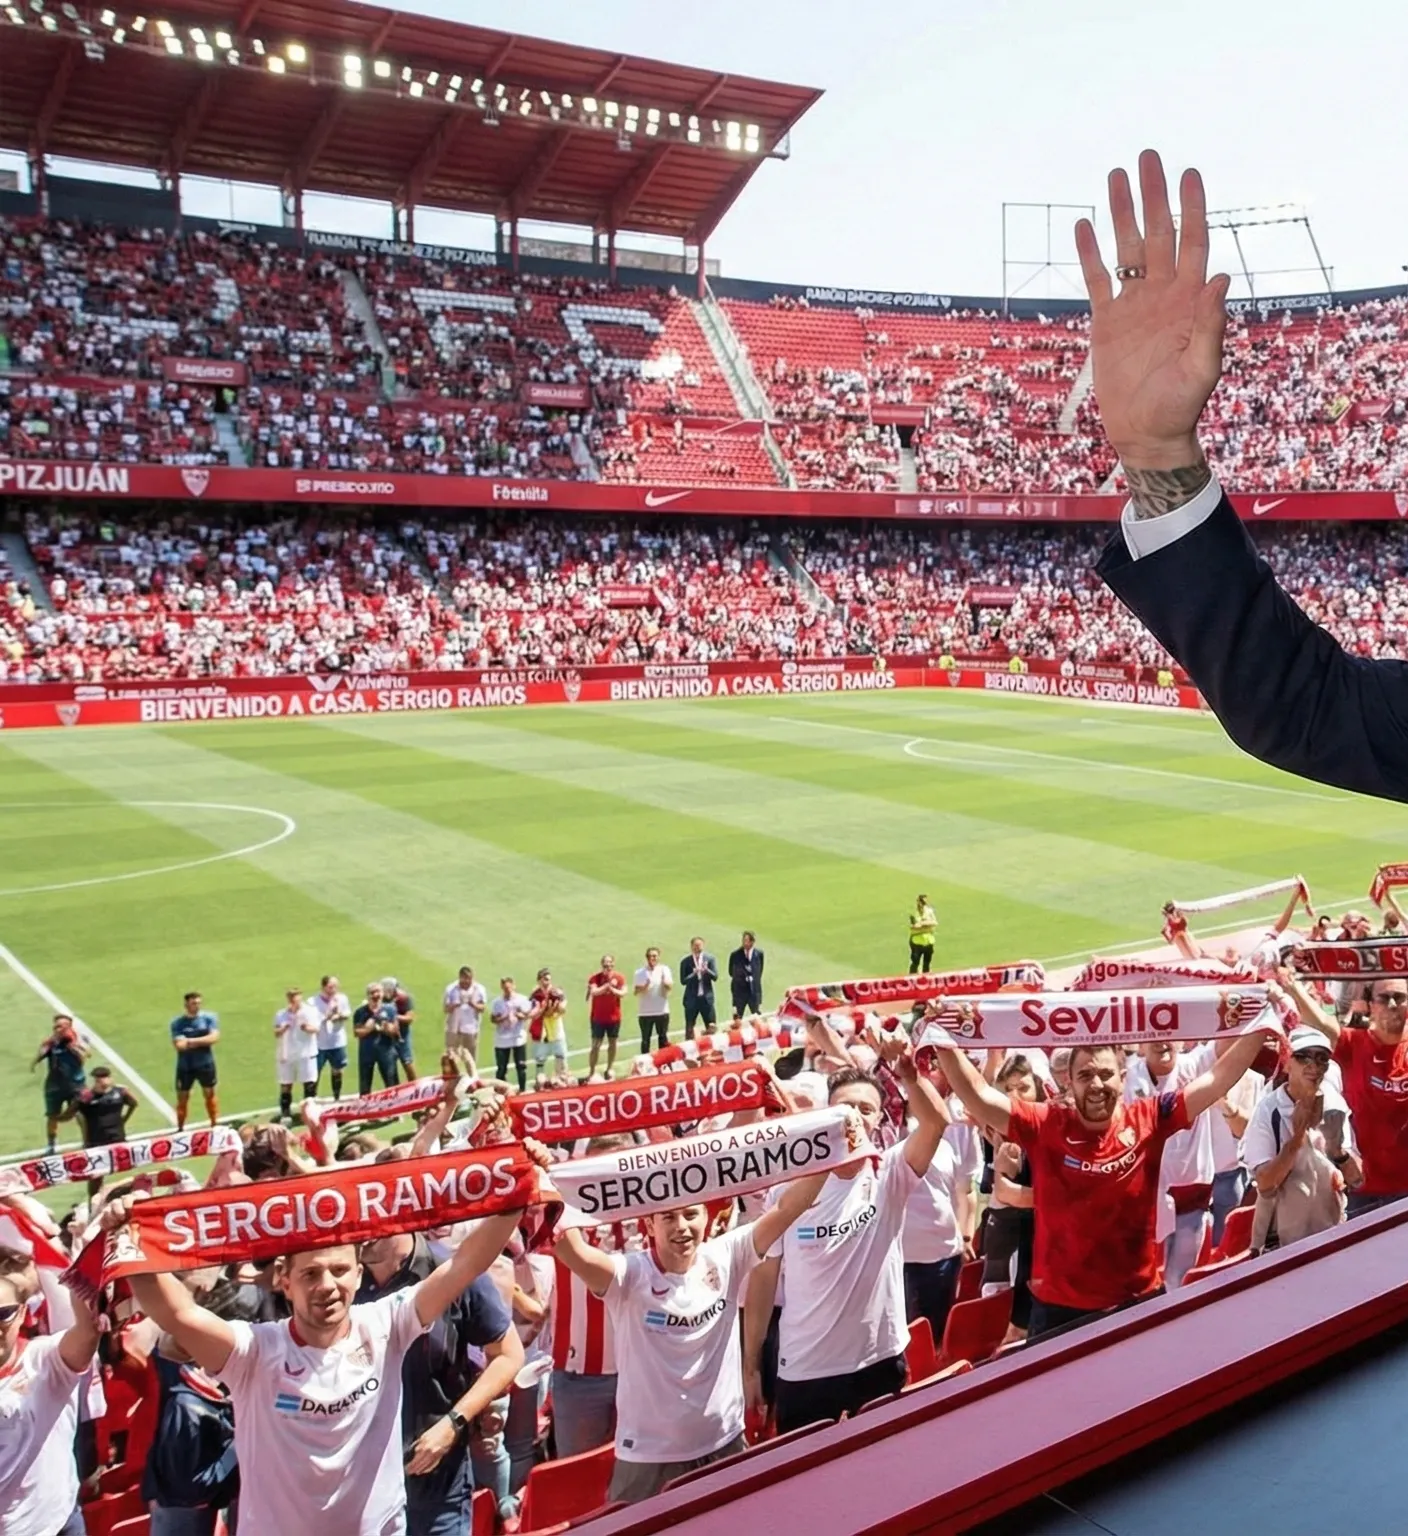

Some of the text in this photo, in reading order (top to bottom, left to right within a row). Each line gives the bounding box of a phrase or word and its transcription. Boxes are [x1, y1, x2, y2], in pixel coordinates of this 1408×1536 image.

[140, 684, 527, 722] BIENVENIDO A CASA, SERGIO RAMOS
[610, 671, 895, 701] BIENVENIDO A CASA, SERGIO RAMOS
[1050, 680, 1059, 696] A
[1137, 686, 1181, 707] RAMOS
[1020, 996, 1179, 1037] Sevilla
[521, 1068, 760, 1133] SERGIO RAMOS
[617, 1125, 788, 1173] BIENVENIDO A CASA
[577, 1131, 831, 1214] SERGIO RAMOS
[163, 1157, 516, 1252] SERGIO RAMOS
